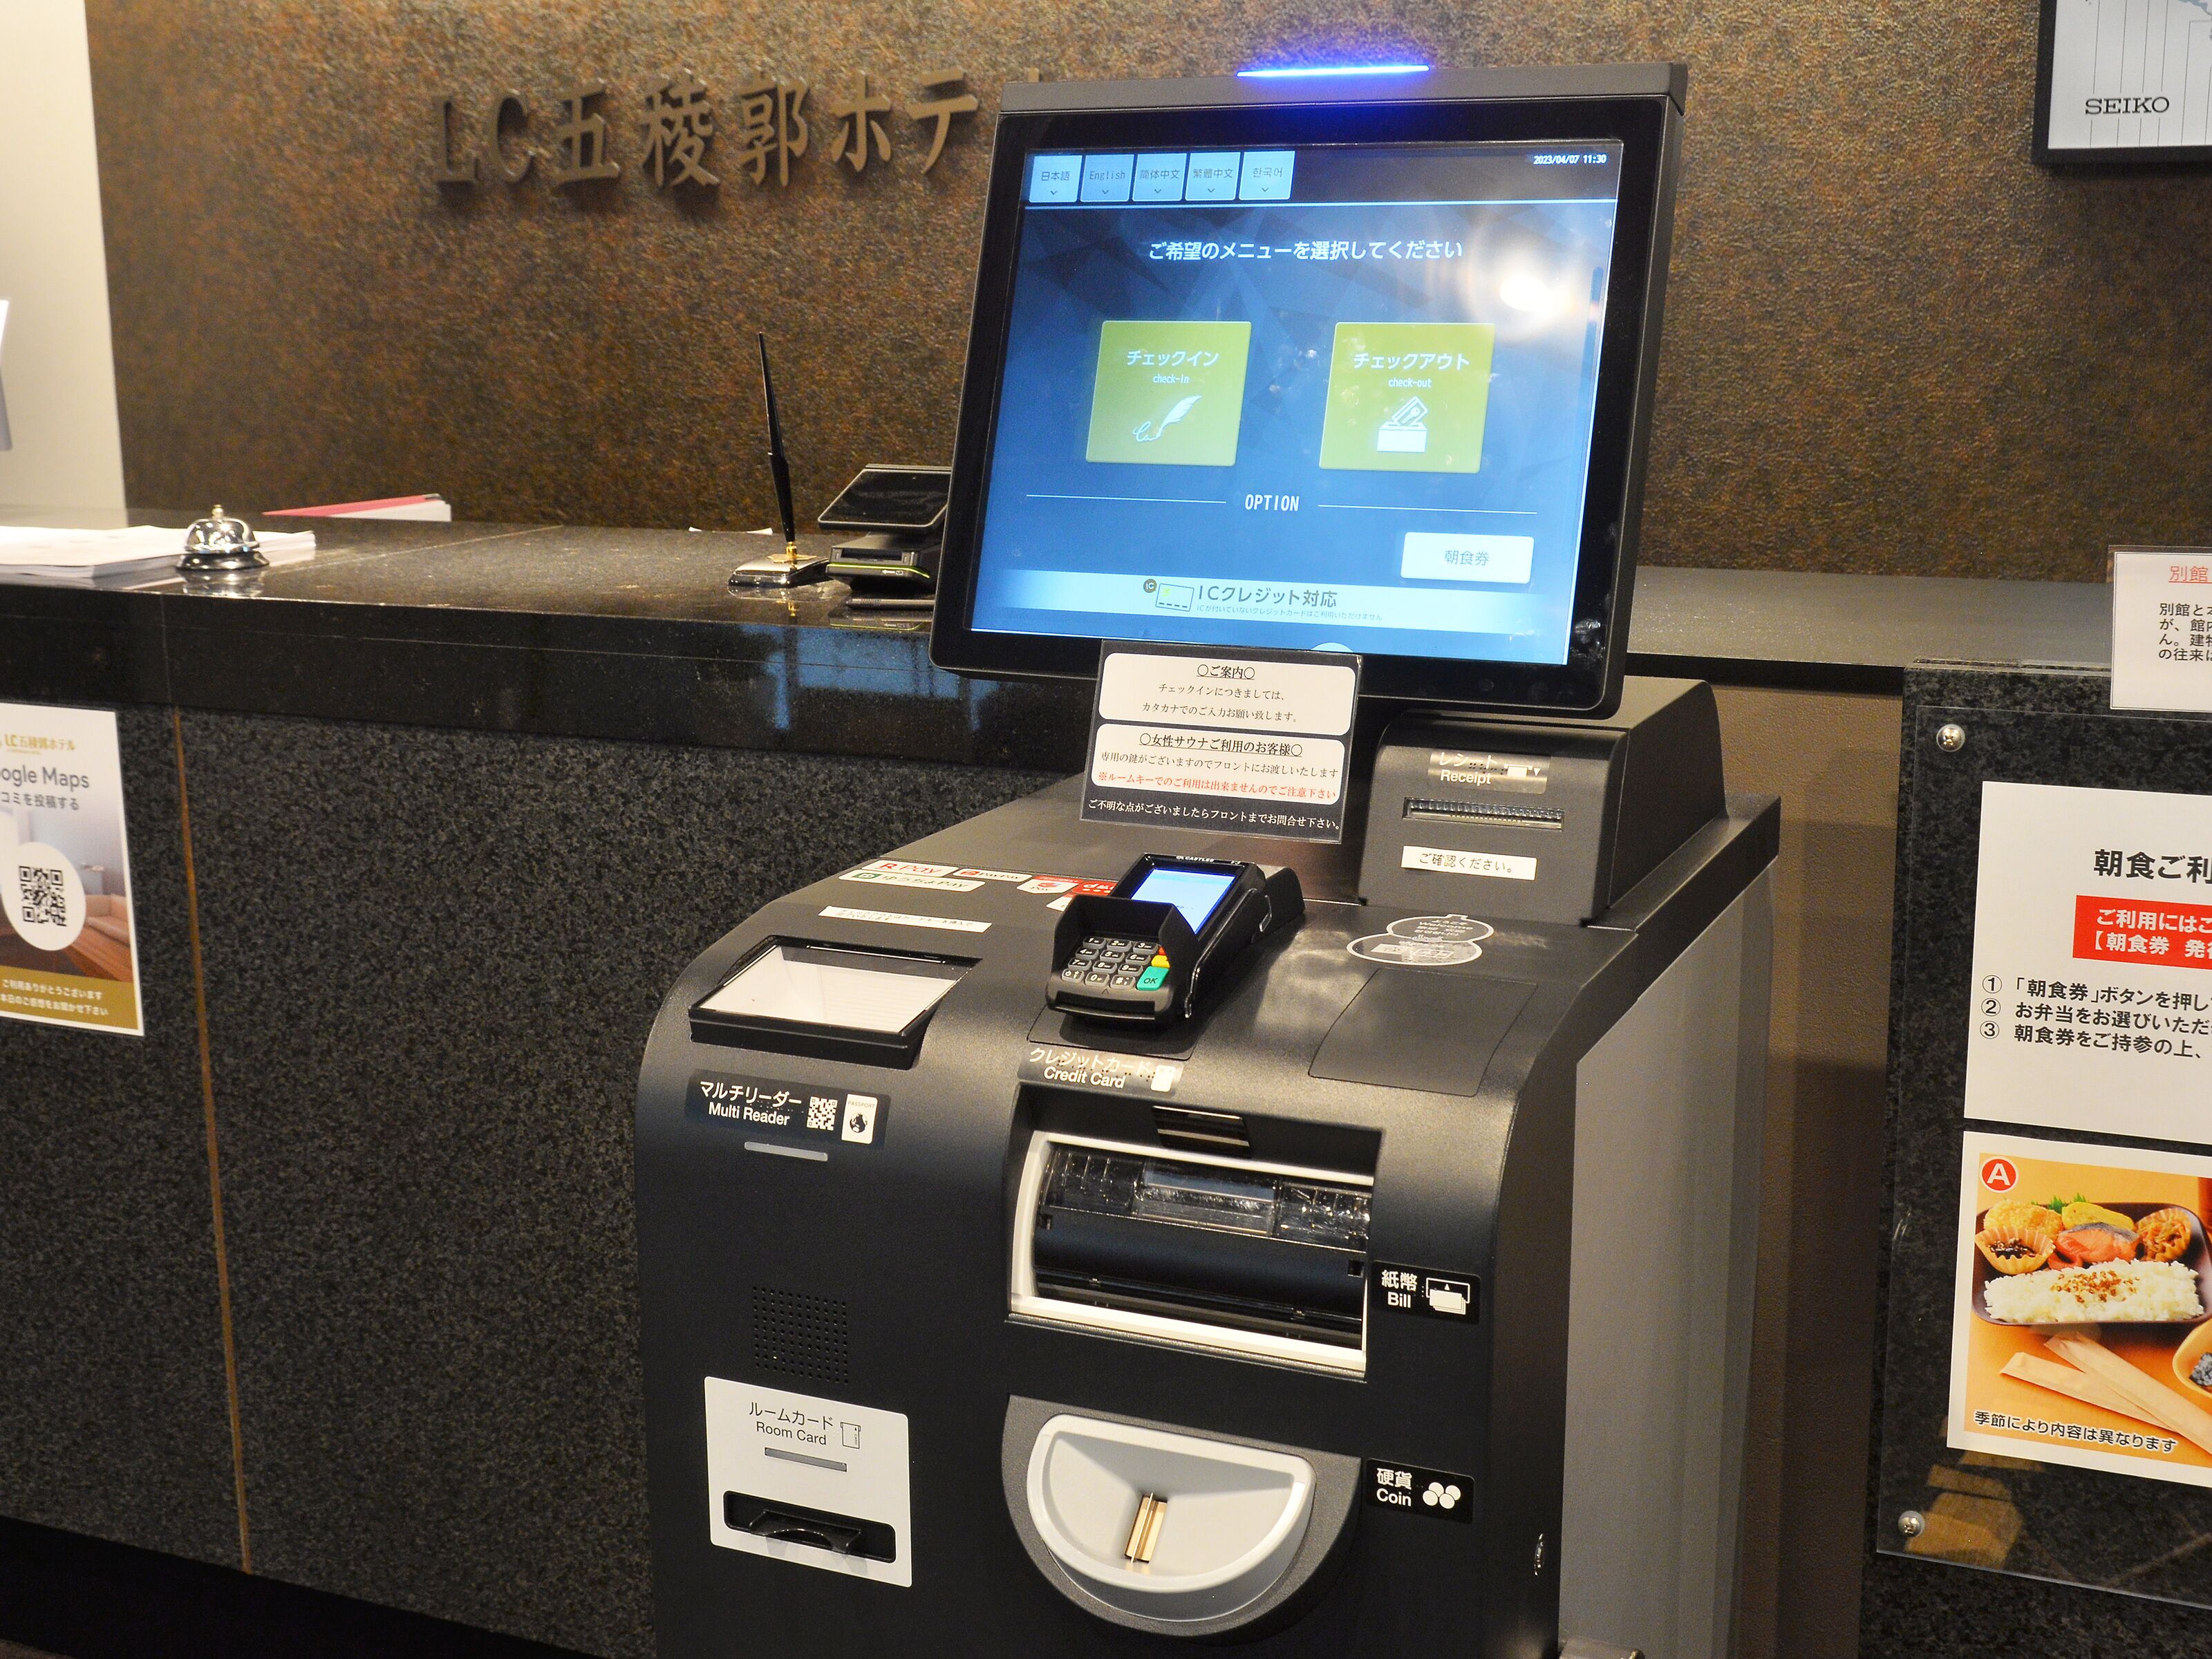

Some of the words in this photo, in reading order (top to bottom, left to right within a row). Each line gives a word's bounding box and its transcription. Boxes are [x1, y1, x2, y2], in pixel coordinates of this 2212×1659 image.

[2085, 97, 2169, 115] SEIKO
[431, 67, 1040, 189] LC五稜郭ホテ
[1533, 155, 1580, 165] 2023/04/07
[1583, 153, 1606, 164] 11:30
[1040, 171, 1070, 182] 日本語
[1089, 169, 1125, 181] English
[1252, 167, 1283, 178] 한국어
[1148, 240, 1463, 261] ご希望のメニューを選択してください
[1127, 349, 1219, 368] チェックイン
[1353, 352, 1470, 371] チェックアウト
[1152, 373, 1190, 384] check-in
[1388, 376, 1432, 389] check-out
[1244, 494, 1300, 512] OPTION
[1443, 550, 1490, 568] 朝食券
[2168, 565, 2209, 583] 別館
[1199, 585, 1338, 608] ICクレジット対応
[1159, 682, 1285, 701] チェックインにつきましては、
[1142, 702, 1298, 723] カタカナでのご入力お願い致します。
[1100, 751, 1338, 778] 専用の鍵がございますのでフロントにお渡しいたします
[1439, 751, 1498, 769] レシート
[0, 765, 37, 787] ogle
[42, 766, 89, 792] Maps
[1098, 771, 1336, 800] ※ルームキーでのご利用は出来ませんのでご注意下さい
[1440, 769, 1491, 786] Receipt
[1088, 798, 1340, 830] ご不明な点がございましたらフロントまでお問合せ下さい。
[1419, 853, 1512, 874] ご確認ください。
[2094, 848, 2212, 884] 朝食ご利
[2015, 977, 2212, 1012] 「朝食券」ボタンを押し
[2015, 1002, 2212, 1035] お弁当をお選びいただ
[2014, 1023, 2212, 1059] 朝食券をご持参の上、
[1029, 1047, 1155, 1076] クレジットカード
[1044, 1065, 1087, 1084] Credit
[1090, 1070, 1125, 1089] Card
[700, 1080, 802, 1107] マルチリーダー
[708, 1101, 740, 1119] Multi
[743, 1106, 791, 1126] Reader
[847, 1100, 875, 1109] PASSPORT
[1986, 1163, 2011, 1186] A
[1381, 1270, 1418, 1291] 紙幣
[1387, 1291, 1412, 1309] Bill
[749, 1402, 833, 1430] ルームカード
[756, 1421, 793, 1438] Room
[796, 1429, 827, 1445] Card
[1974, 1409, 2178, 1454] 季節により内容は異なります
[1376, 1468, 1412, 1490] 硬貨
[1376, 1488, 1412, 1507] Coin
